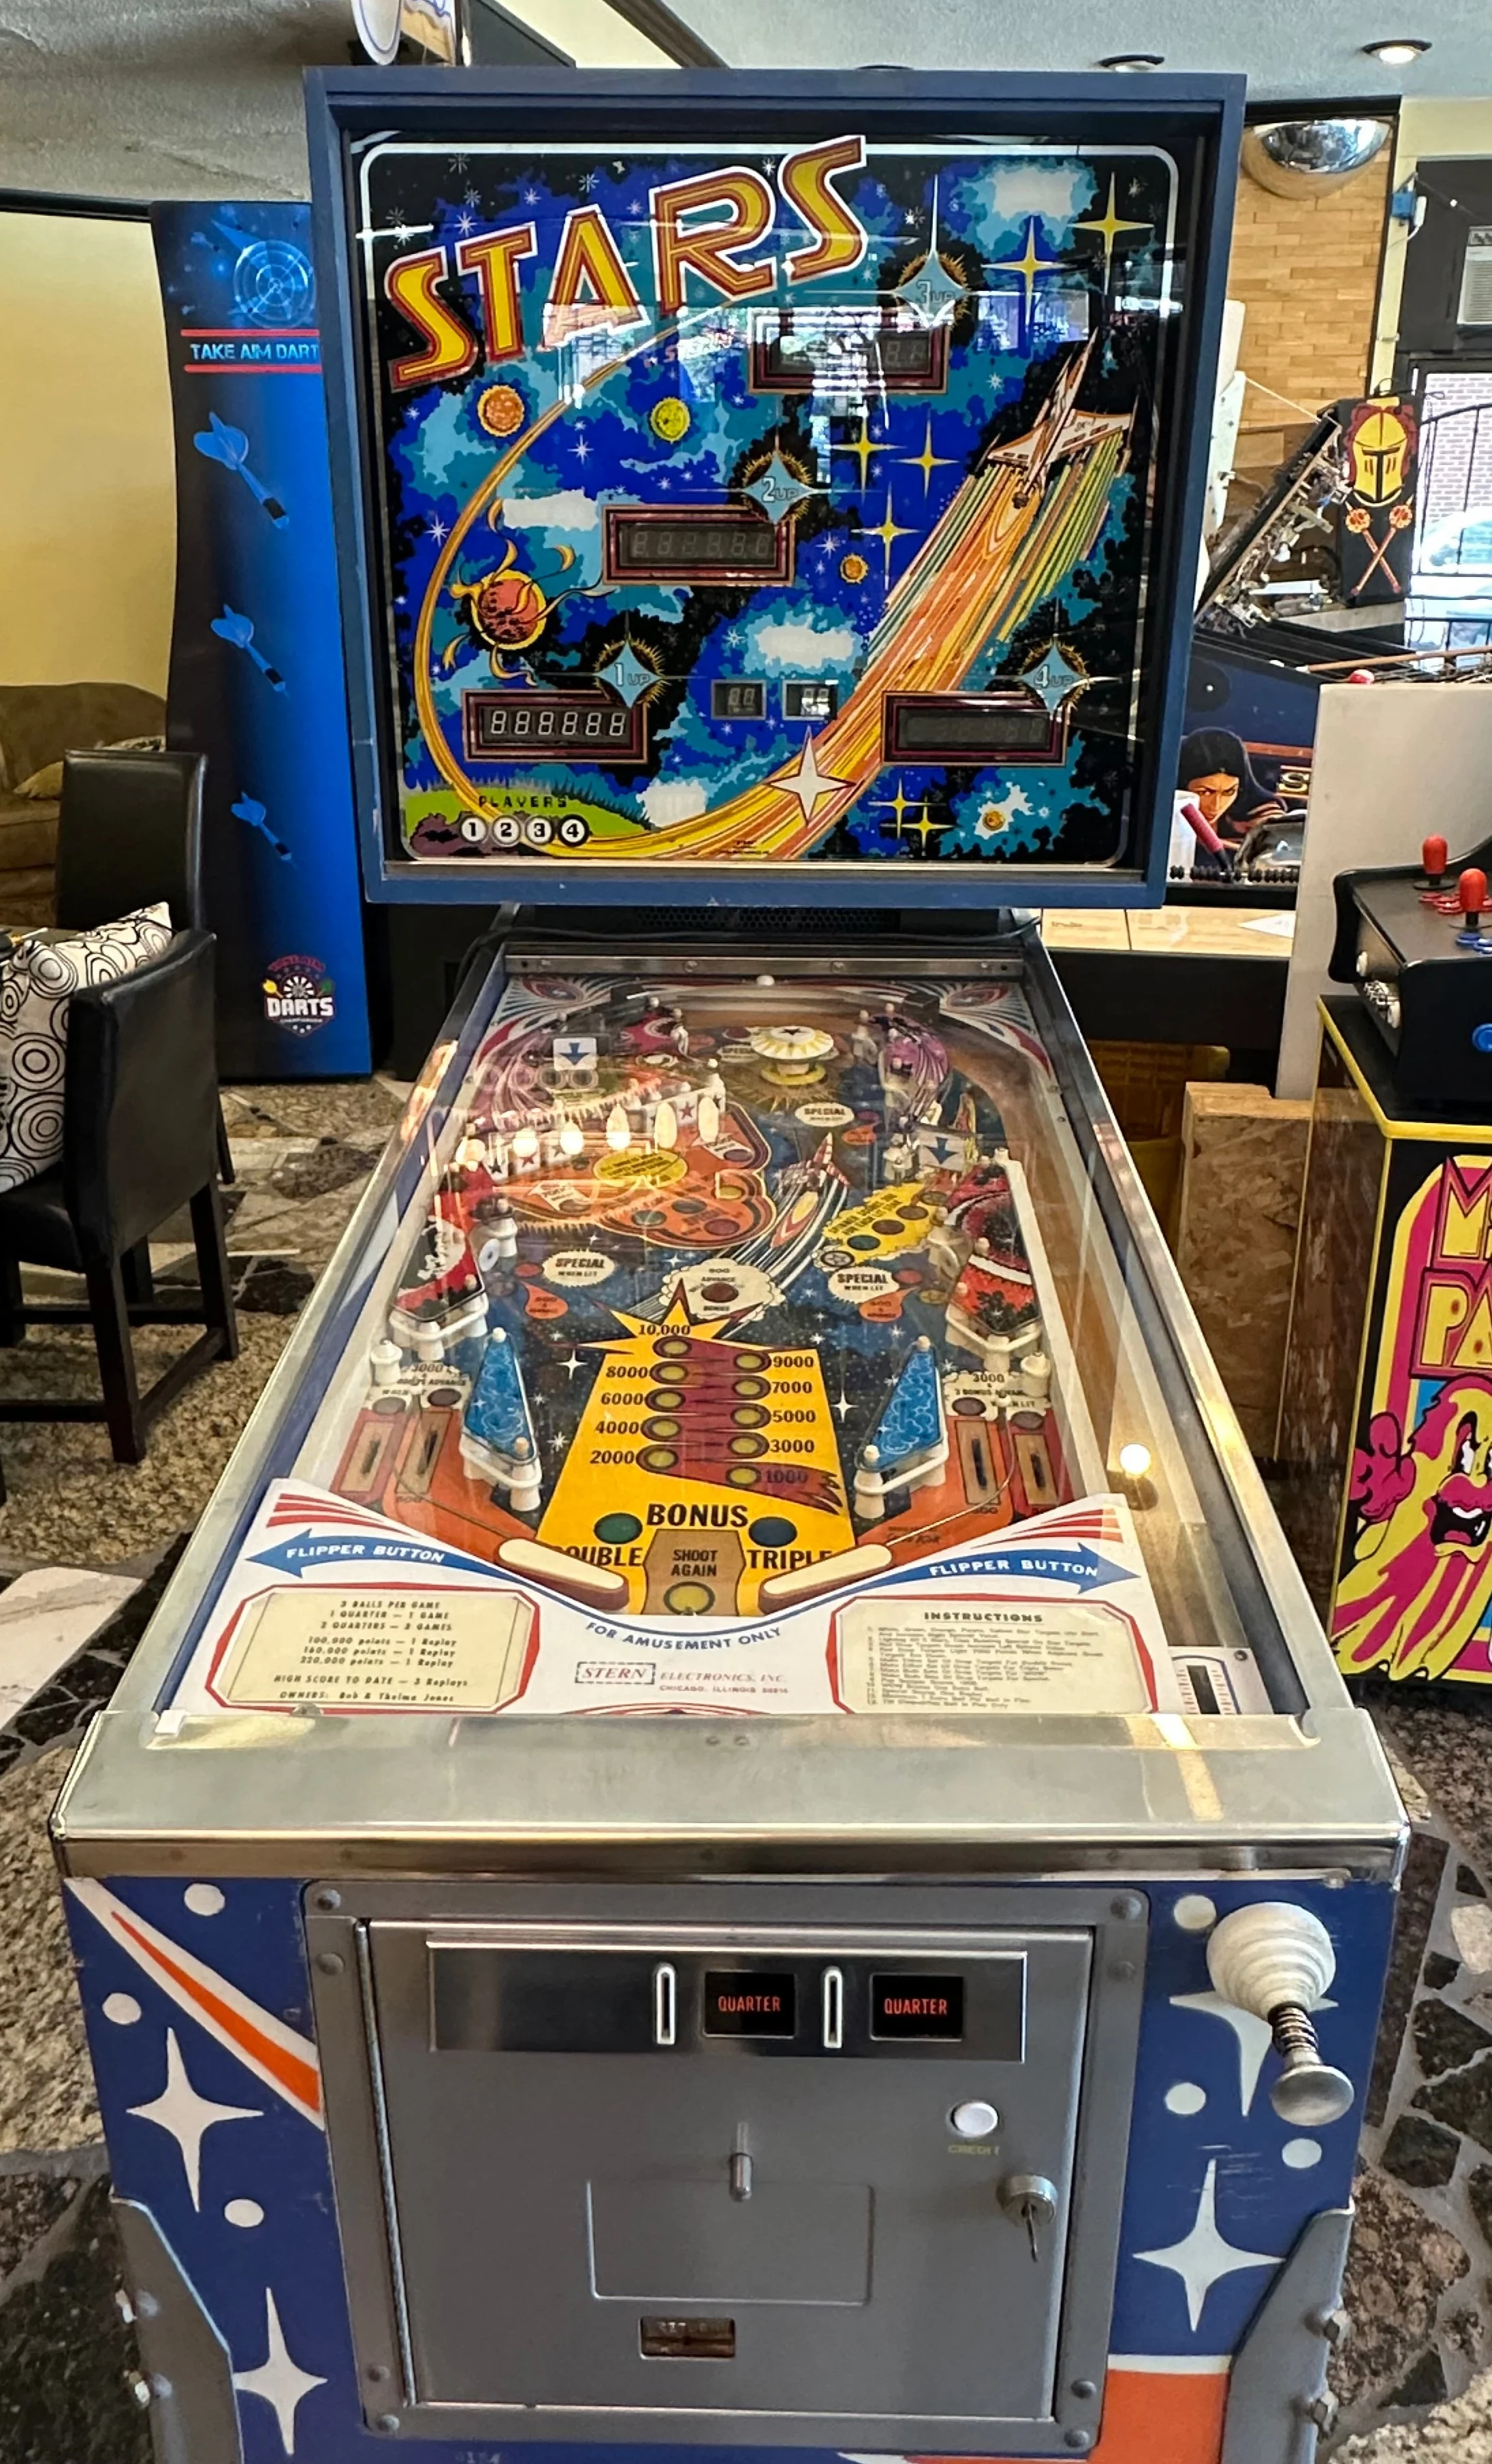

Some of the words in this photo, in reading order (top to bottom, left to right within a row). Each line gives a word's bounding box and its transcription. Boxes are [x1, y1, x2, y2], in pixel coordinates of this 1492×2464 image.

[385, 135, 866, 393] STARS
[190, 343, 236, 360] TAKE
[240, 344, 271, 360] AIM
[479, 795, 567, 808] PLAYERS
[501, 823, 512, 838] 2
[534, 823, 545, 838] 3
[567, 823, 580, 838] 4
[266, 997, 334, 1017] DARTS
[804, 1107, 846, 1116] SPECIAL
[555, 1257, 605, 1269] SPECIAL
[837, 1274, 889, 1284] SPECIAL
[638, 1323, 691, 1337] 10,000
[772, 1356, 814, 1368] 9000
[605, 1366, 650, 1379] 8000
[772, 1381, 813, 1394] 7000
[601, 1393, 644, 1406] 6000
[772, 1410, 816, 1423] 5000
[595, 1421, 639, 1434] 4000
[770, 1440, 815, 1453] 3000
[589, 1451, 635, 1465] 2000
[766, 1470, 809, 1484] 1000
[646, 1503, 749, 1528] BONUS
[286, 1544, 364, 1560] FLIPPER
[373, 1545, 445, 1563] BUTTON
[554, 1546, 644, 1567] OUBLE
[673, 1549, 718, 1562] SHOOT
[671, 1564, 717, 1577] AGAIN
[929, 1559, 1011, 1577] FLIPPER
[1021, 1560, 1098, 1577] BUTTON
[387, 1600, 407, 1609] PER
[411, 1601, 441, 1609] GAME
[340, 1610, 387, 1618] QUARTER
[419, 1611, 449, 1620] GAME
[924, 1611, 1043, 1623] INSTRUCTIONS
[332, 1621, 386, 1630] QUARTERS
[416, 1622, 453, 1631] GAMES
[358, 1637, 391, 1646] points
[422, 1637, 457, 1647] Replay
[584, 1621, 617, 1639] FOR
[622, 1634, 731, 1650] AMUSEMENT
[738, 1627, 782, 1646] ONLY
[352, 1647, 386, 1656] points
[419, 1647, 456, 1658] Replay
[349, 1657, 384, 1667] points
[417, 1658, 454, 1668] Replay
[582, 1666, 648, 1680] STERN
[273, 1675, 302, 1683] HIGH
[306, 1675, 340, 1684] SCORE
[346, 1676, 360, 1684] TO
[364, 1676, 394, 1685] DATE
[426, 1677, 469, 1688] Replays
[379, 1692, 417, 1701] Thelma
[423, 1693, 455, 1702] Jones
[717, 1995, 781, 2012] QUARTER
[883, 1998, 948, 2015] QUARTER
